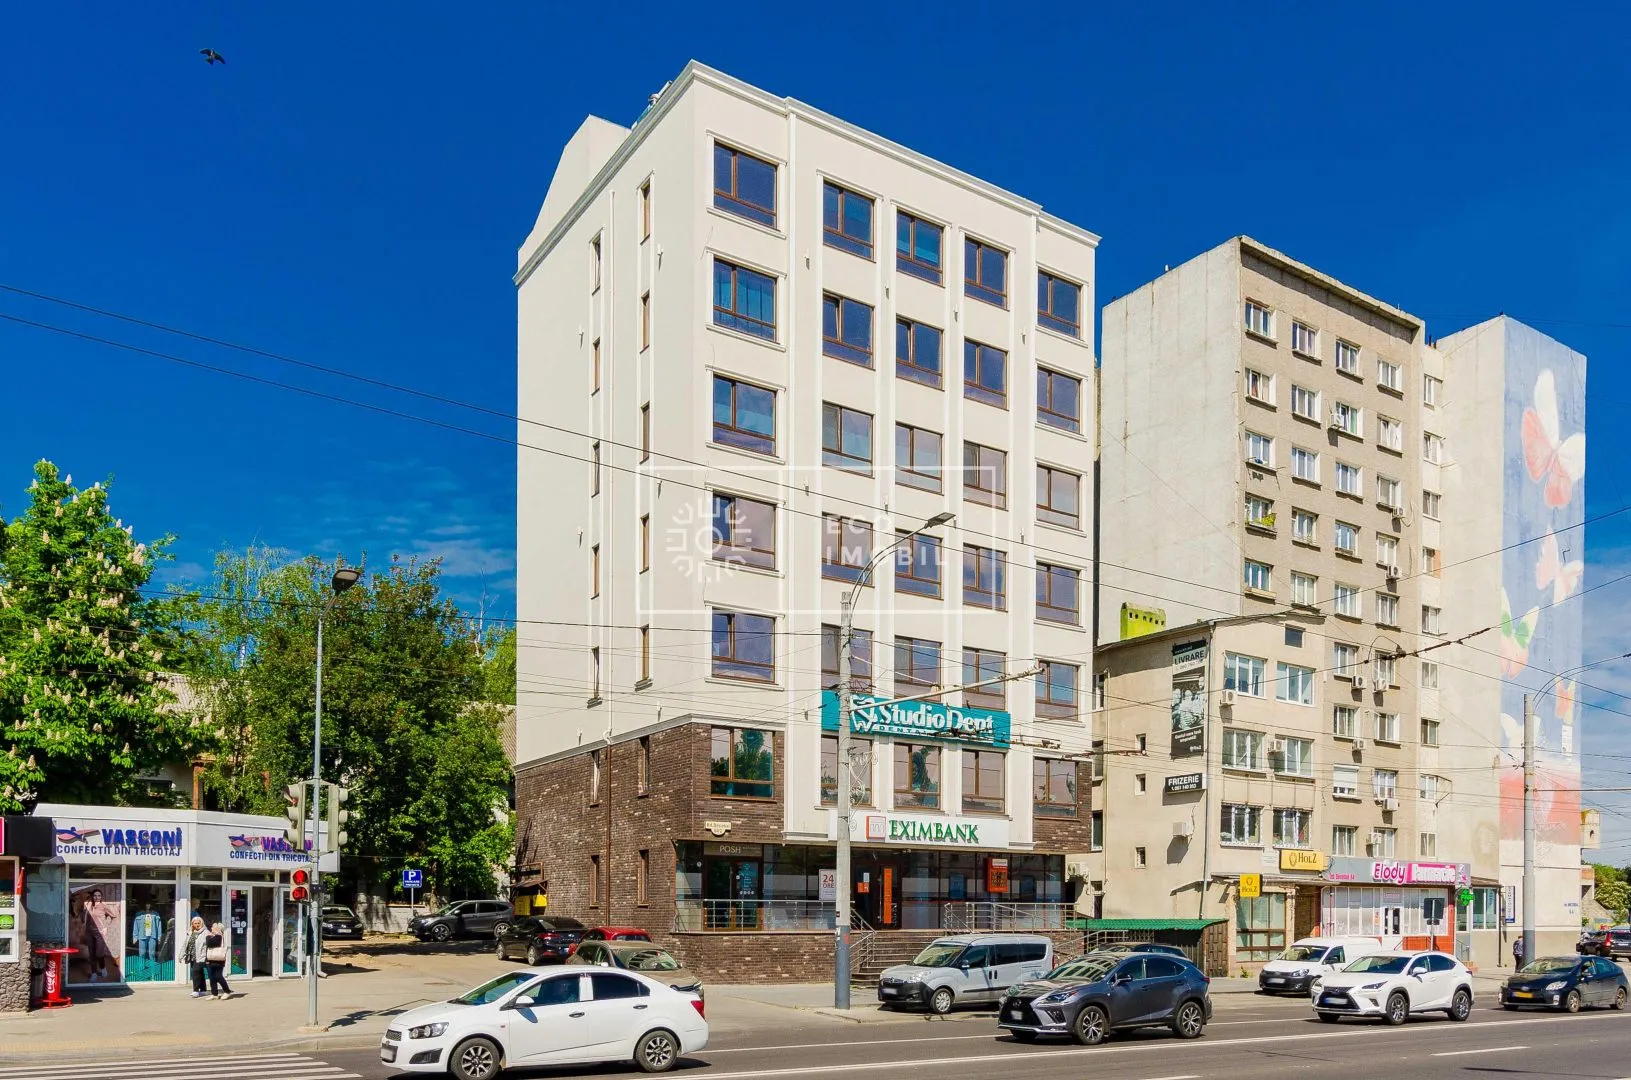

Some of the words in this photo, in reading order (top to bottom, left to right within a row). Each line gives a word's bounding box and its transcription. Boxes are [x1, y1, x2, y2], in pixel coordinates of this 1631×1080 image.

[1174, 650, 1204, 665] LIVRARE
[1168, 775, 1200, 786] FRIZERIE
[889, 819, 979, 843] EXIMBANK
[114, 847, 131, 856] DIN
[135, 847, 181, 857] TRICOTAJ
[720, 845, 741, 854] POSH
[269, 852, 280, 861] DIN
[282, 853, 311, 863] TRICOTA
[408, 871, 416, 880] P
[823, 874, 834, 883] 24
[1374, 862, 1406, 884] Elody
